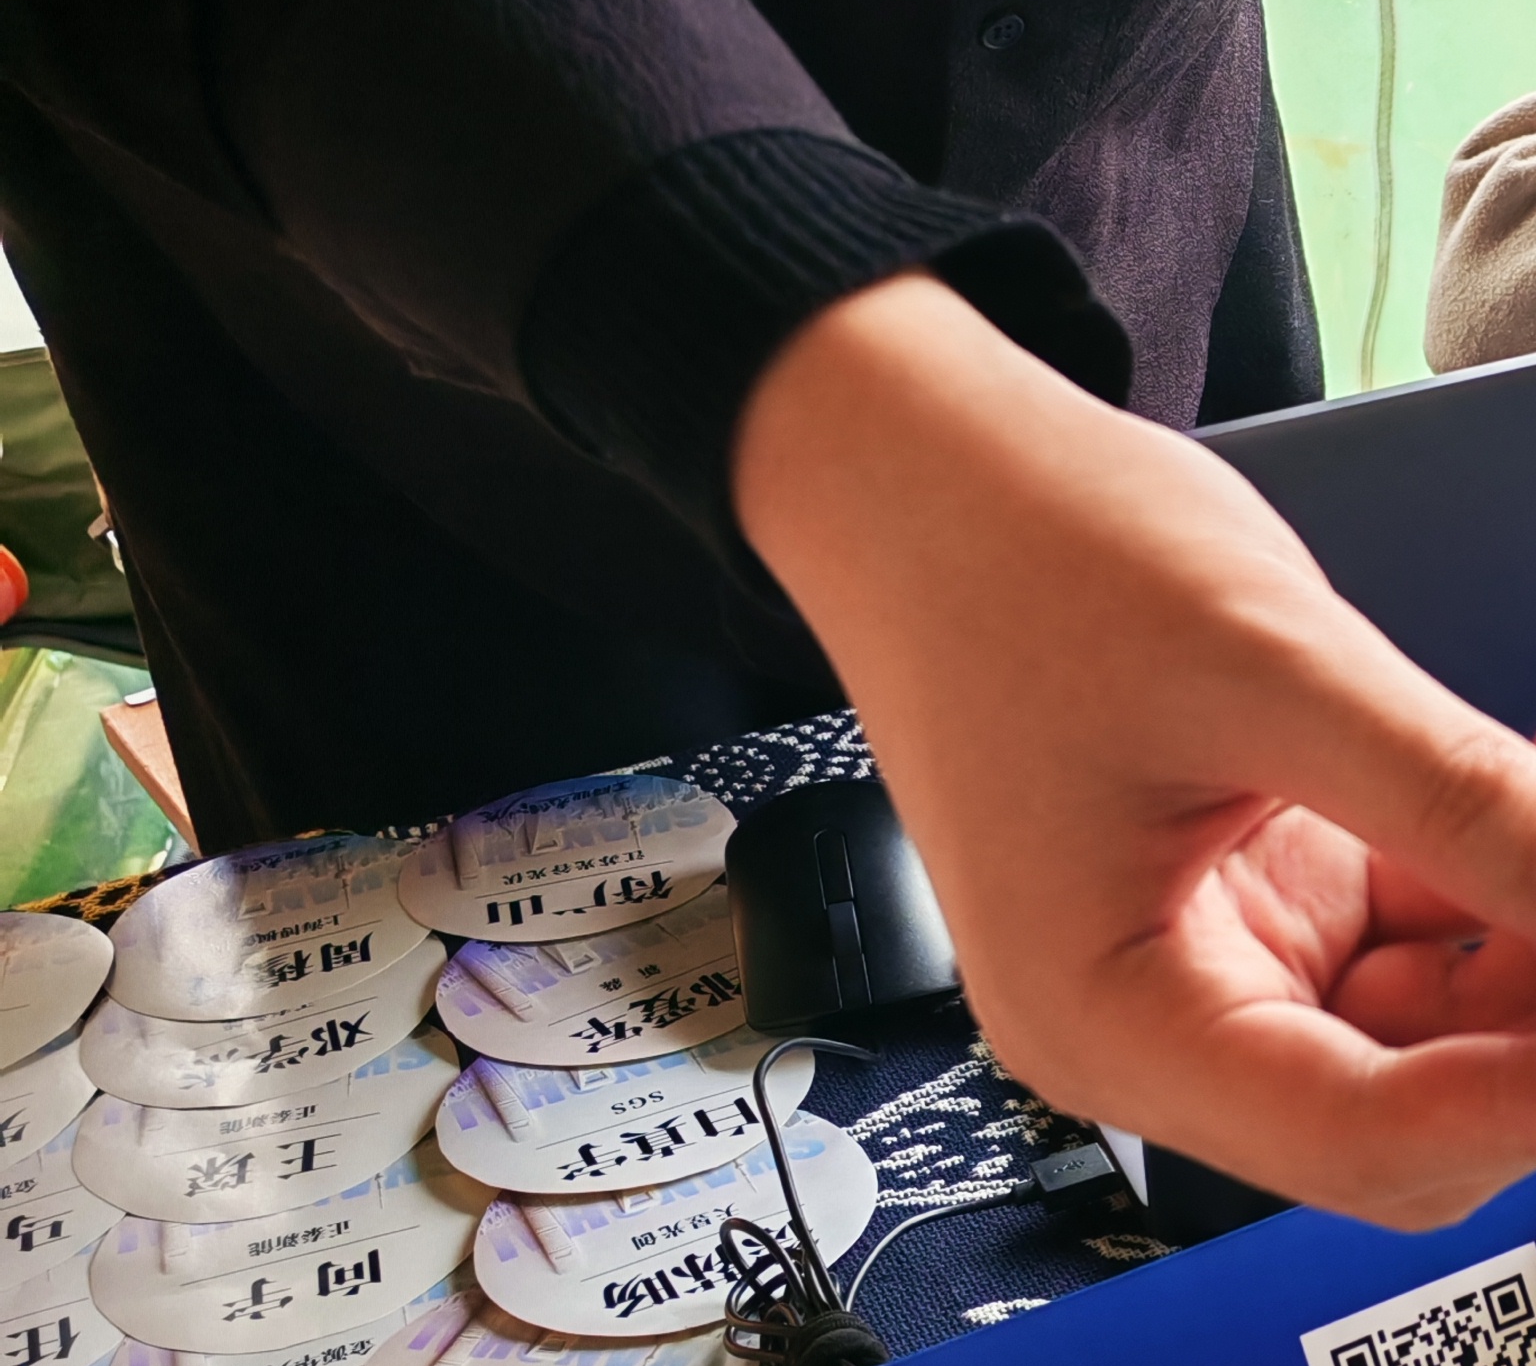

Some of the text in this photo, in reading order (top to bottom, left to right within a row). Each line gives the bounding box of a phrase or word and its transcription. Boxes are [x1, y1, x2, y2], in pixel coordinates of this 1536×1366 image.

[502, 850, 645, 886] 江苏光谷光伏
[486, 870, 673, 927] 符广山
[219, 1104, 318, 1135] 正泰新能
[610, 1090, 664, 1116] SGS
[556, 1097, 760, 1182] 白真宇
[183, 1133, 341, 1197] 王琛
[5, 1210, 74, 1252] 马
[248, 1219, 352, 1257] 正泰新能
[630, 1202, 739, 1251] 天昱光创
[222, 1248, 382, 1322] 向宇
